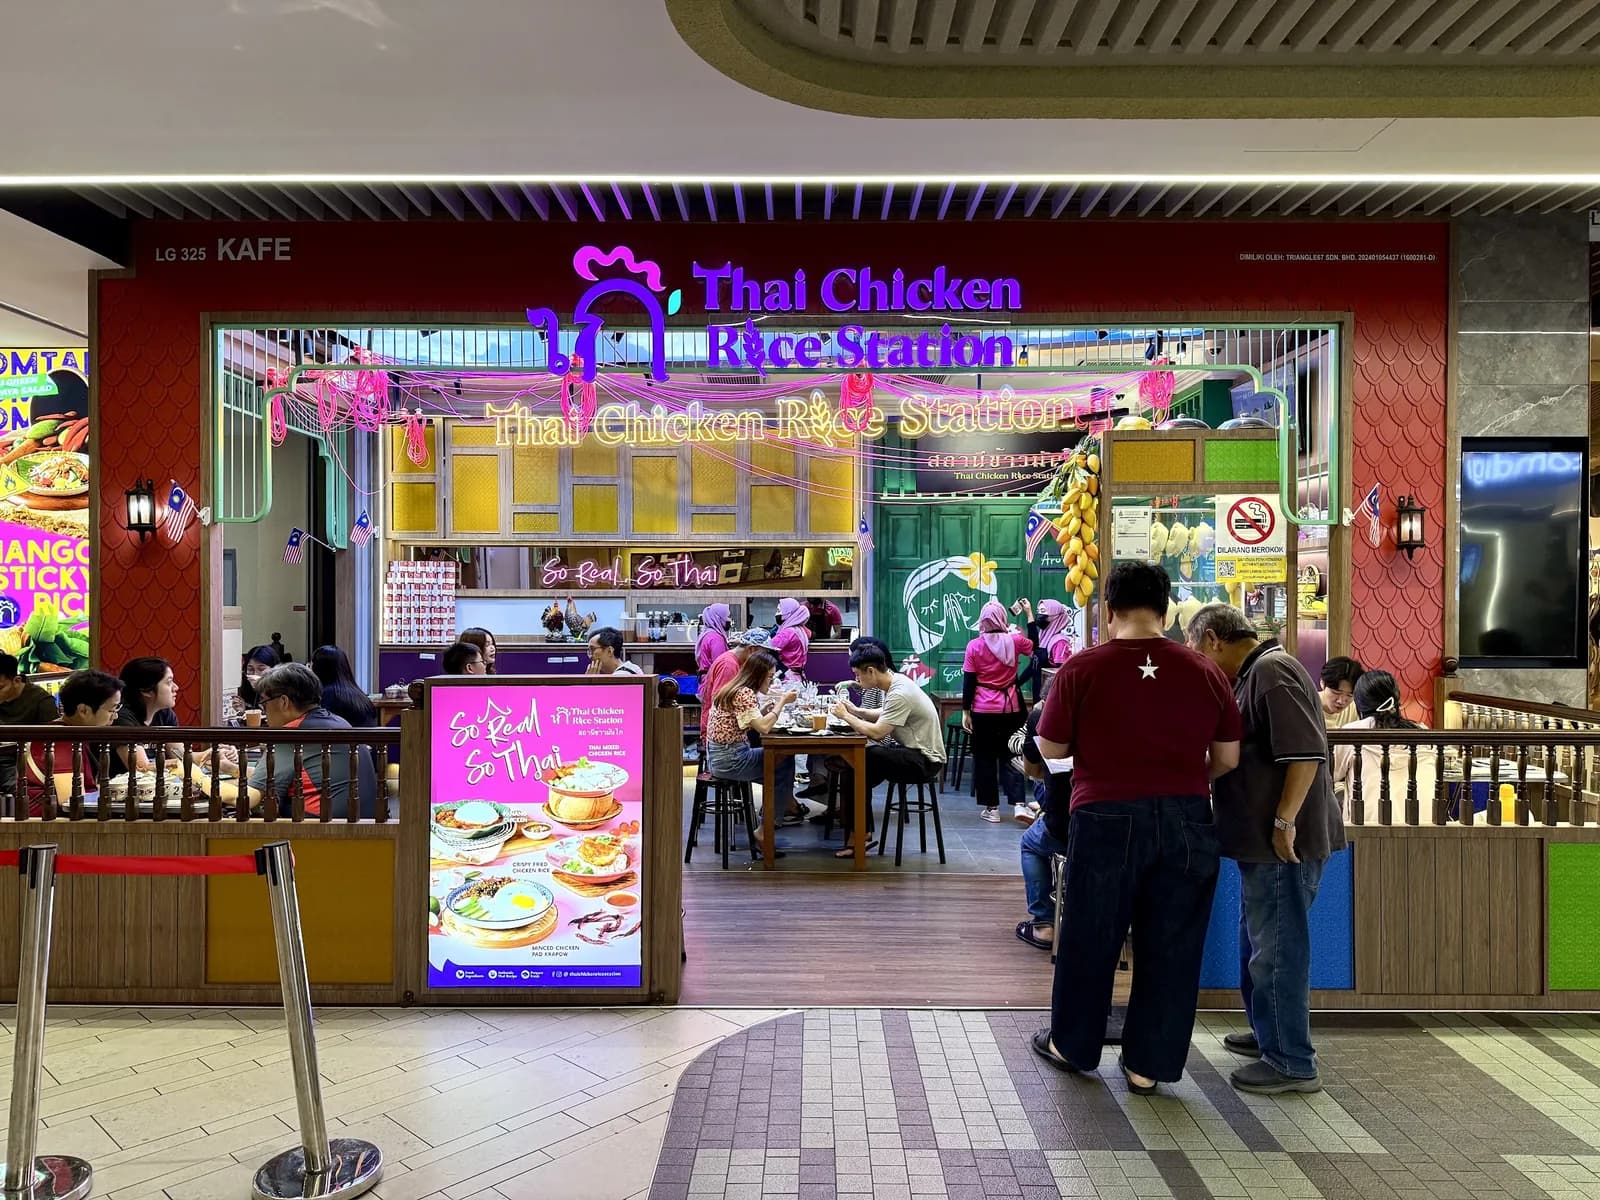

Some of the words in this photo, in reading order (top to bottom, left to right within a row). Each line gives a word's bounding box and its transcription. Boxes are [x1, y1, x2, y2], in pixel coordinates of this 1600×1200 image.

[155, 247, 177, 261] LG
[180, 247, 207, 261] 325
[217, 237, 292, 261] KAFE
[1239, 253, 1264, 261] DIMILIKI
[1265, 253, 1285, 261] OLEH:
[1341, 253, 1357, 261] BHD.
[692, 260, 807, 312] Thai
[819, 265, 1023, 312] Chicken
[706, 317, 823, 378] Rice
[836, 322, 1015, 369] Station
[485, 400, 582, 447] Thai
[592, 400, 764, 445] Chicken
[777, 391, 886, 448] Rice
[899, 387, 1075, 436] Station
[953, 471, 974, 480] Thai
[975, 471, 1009, 480] Chicken
[0, 539, 89, 564] ANGO
[1217, 546, 1250, 554] DILARANG
[1251, 546, 1284, 554] MEROKOK
[542, 557, 568, 585] So
[636, 557, 664, 586] So
[667, 553, 718, 586] Thai
[33, 592, 89, 617] RIC
[450, 712, 480, 748] So
[477, 697, 541, 748] Real
[571, 707, 590, 716] Thai
[591, 707, 625, 716] Chicken
[572, 716, 593, 725] Rice
[593, 716, 623, 725] Station
[465, 749, 495, 785] So
[492, 740, 563, 782] Thai
